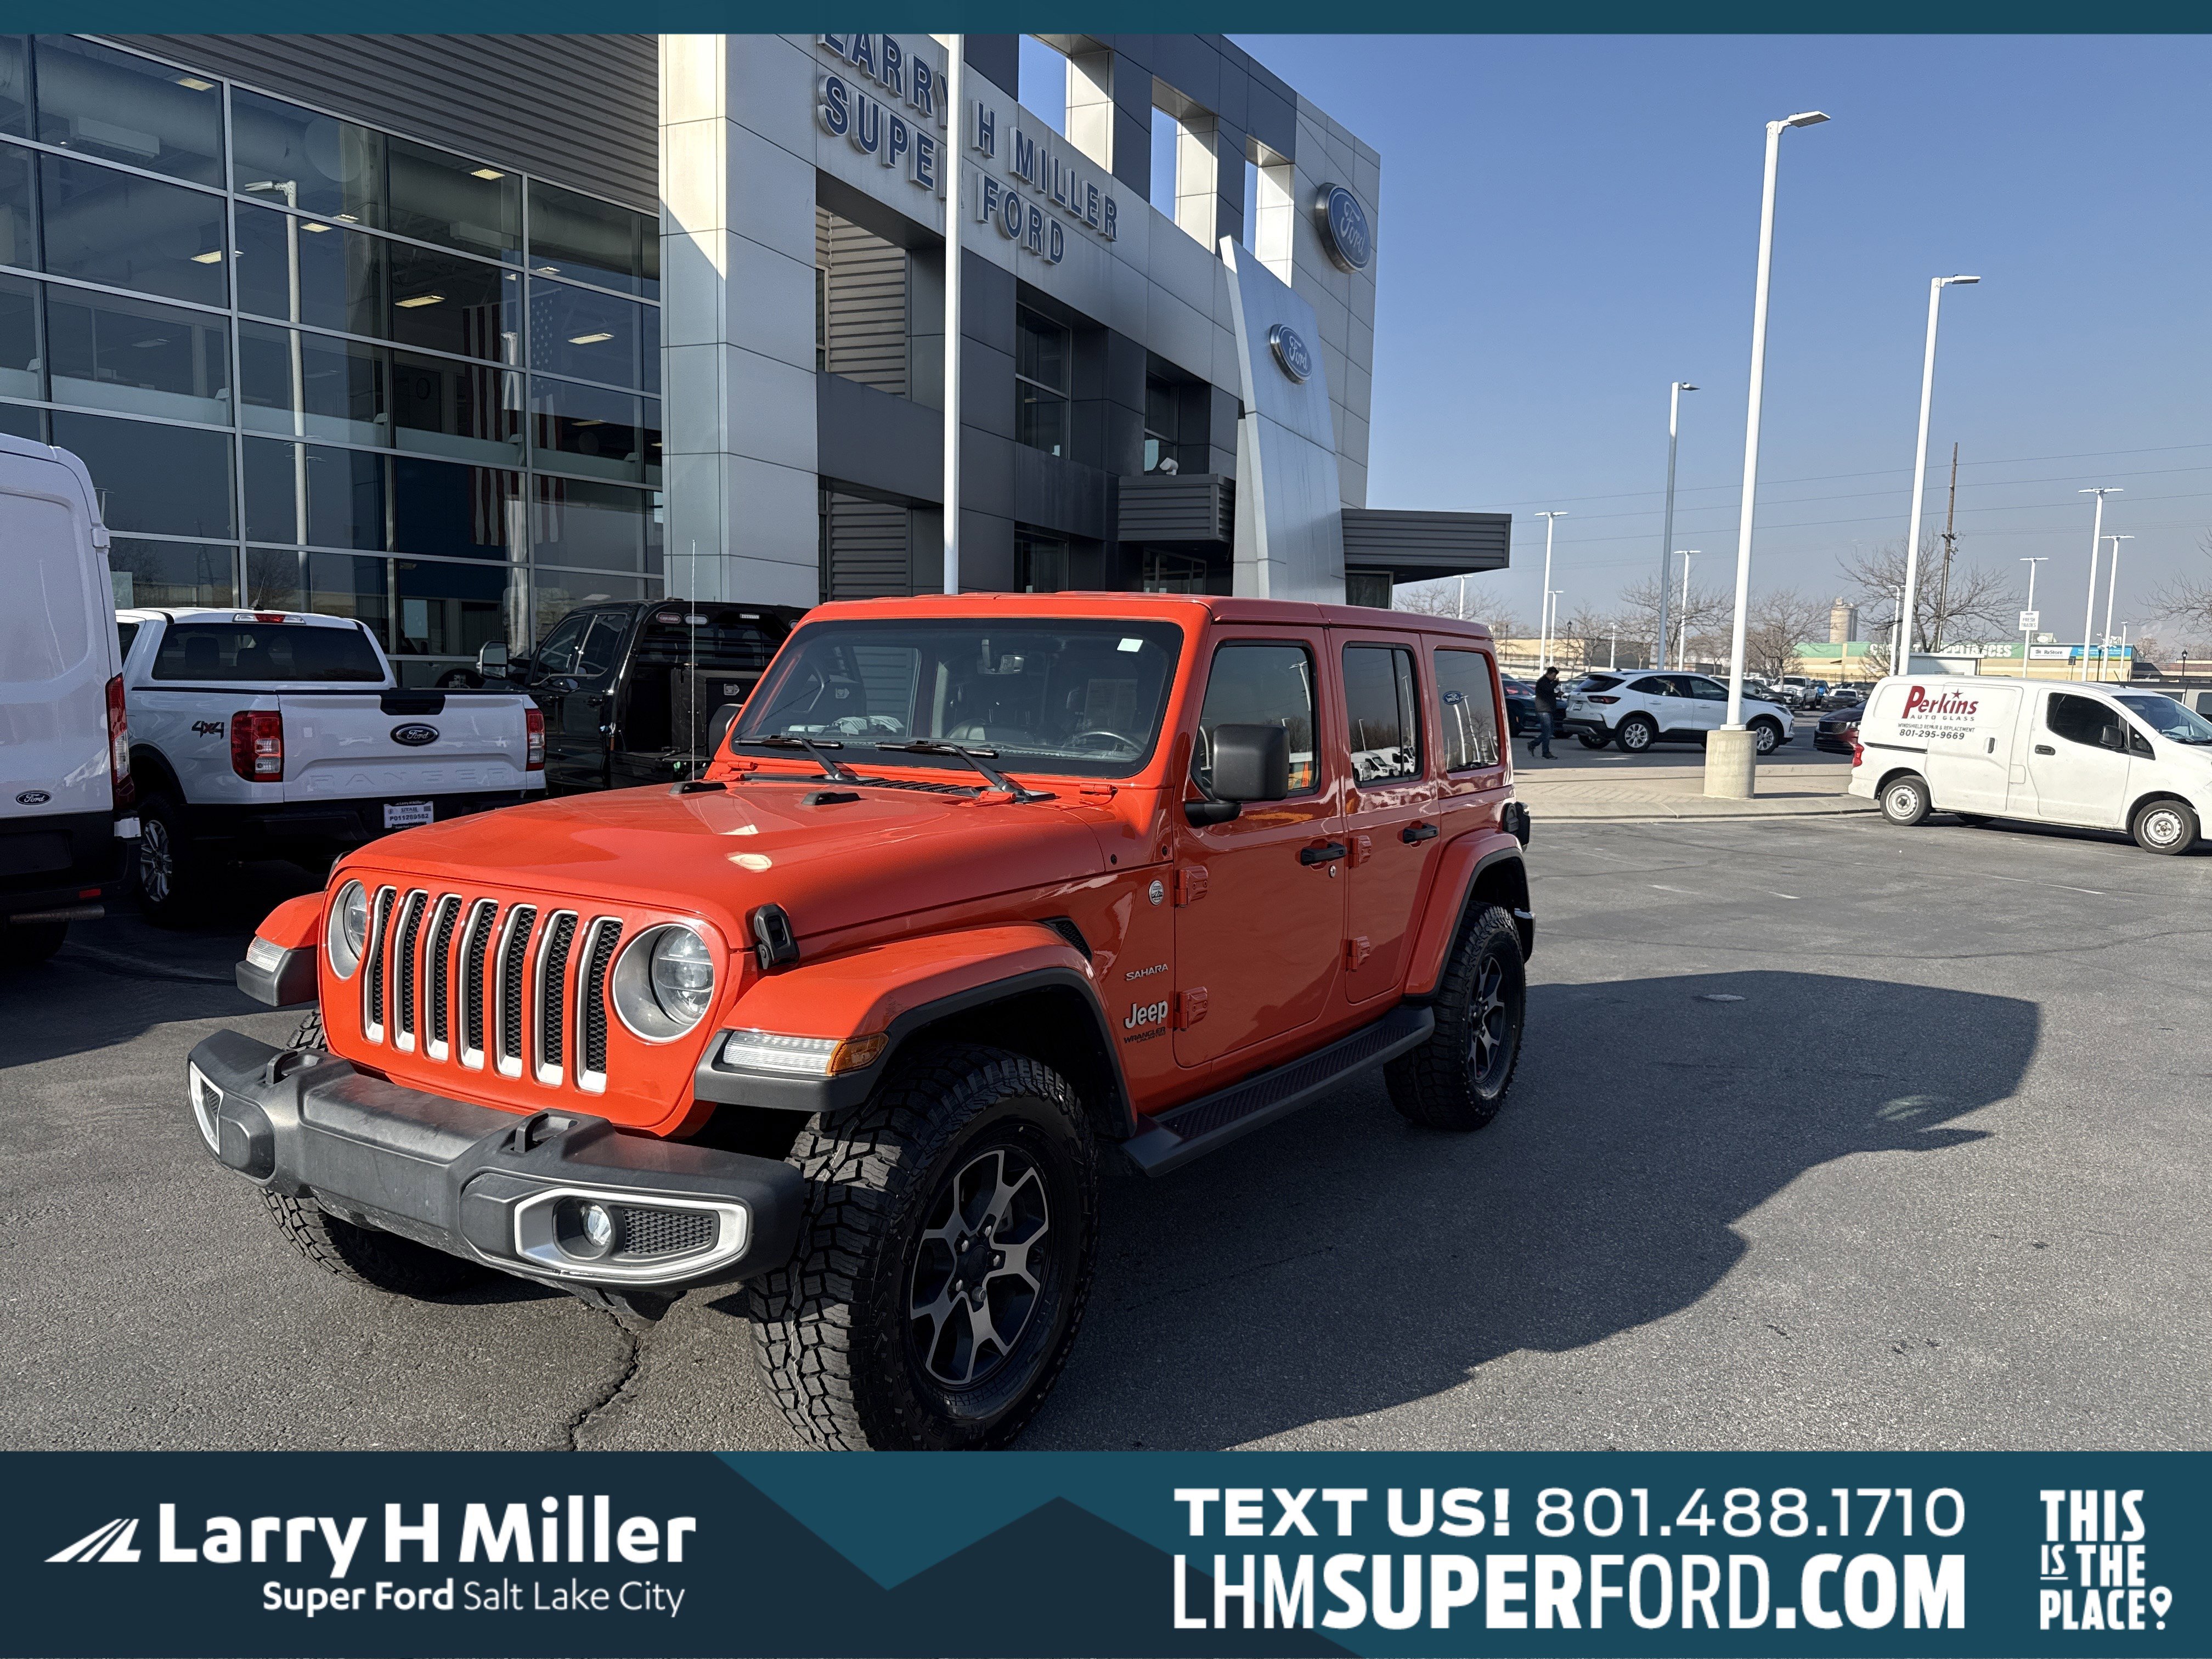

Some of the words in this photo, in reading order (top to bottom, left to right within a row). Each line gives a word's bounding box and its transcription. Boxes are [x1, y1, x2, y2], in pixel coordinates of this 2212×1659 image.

[817, 74, 964, 208] SUPE
[977, 172, 1065, 266] FORD
[972, 99, 996, 159] H
[1009, 126, 1118, 242] MILLER
[1340, 200, 1366, 257] Ford
[1289, 335, 1308, 370] Ford
[1901, 685, 1979, 719] Perkins
[191, 720, 224, 740] 4x4
[407, 730, 429, 740] Ford
[1899, 729, 1965, 740] 801-295-9669
[24, 793, 46, 803] Ford
[1126, 963, 1169, 981] SAHARA
[1124, 1001, 1169, 1029] Jeep
[1124, 1026, 1166, 1043] WRANGLER
